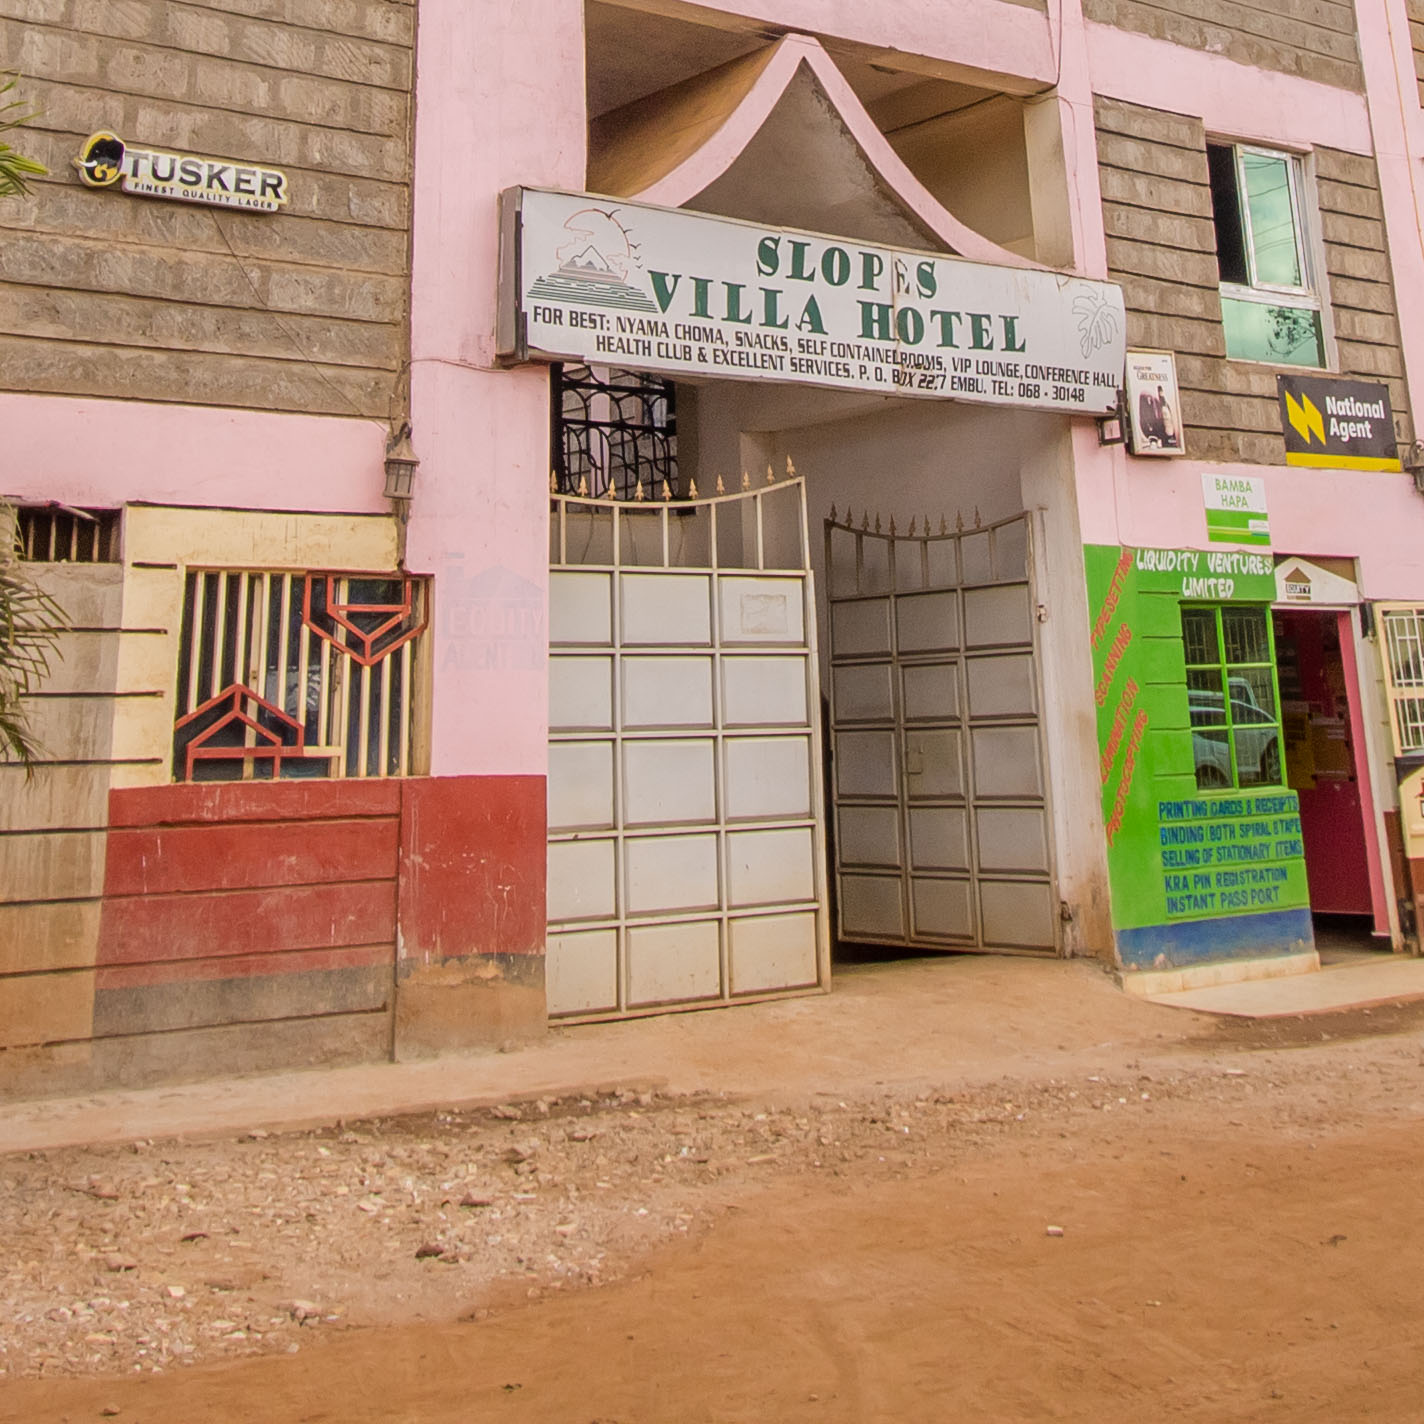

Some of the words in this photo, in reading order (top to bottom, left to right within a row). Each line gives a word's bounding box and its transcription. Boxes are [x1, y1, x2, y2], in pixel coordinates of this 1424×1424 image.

[126, 150, 282, 200] TUSKER
[134, 182, 174, 195] FINEST
[182, 189, 231, 203] QUALITY
[238, 197, 273, 210] LAGER
[648, 270, 828, 335] VILLA
[857, 300, 1027, 353] HOTEL
[533, 305, 564, 326] FOR
[569, 310, 610, 331] BEST:
[616, 316, 669, 339] NYAMA
[675, 324, 729, 347] CHOMA,
[735, 331, 793, 355] SNACKS,
[797, 338, 828, 356] SELF
[952, 356, 972, 374] VIP
[975, 359, 1023, 379] LOUNGE,
[1024, 363, 1089, 385] CONFERENCE
[1093, 371, 1120, 389] HALL,
[596, 335, 652, 357] HEALTH
[657, 342, 692, 362] CLUB
[697, 346, 708, 364] &
[713, 349, 785, 372] EXCELLENT
[859, 365, 869, 380] P.
[951, 376, 987, 394] EMBU.
[991, 380, 1014, 397] TEL:
[1018, 383, 1041, 400] 068
[1052, 385, 1085, 403] 30148
[1326, 396, 1384, 419] National
[1330, 418, 1372, 442] Agent
[1215, 478, 1253, 493] BAMBA
[1221, 494, 1249, 508] HAPA
[1136, 549, 1199, 572] LIQUIDITY
[1207, 552, 1273, 575] VENTURES
[1182, 576, 1234, 598] LIMITED
[1159, 800, 1208, 820] PRINTING
[1211, 800, 1243, 817] CARDS
[1160, 826, 1204, 846] BINDING
[1161, 848, 1200, 867] SELLING
[1202, 847, 1213, 863] OF
[1165, 874, 1189, 893] KRA
[1193, 873, 1212, 890] PIN
[1215, 867, 1288, 888] REGISTRATION
[1167, 893, 1216, 914] INSTANT
